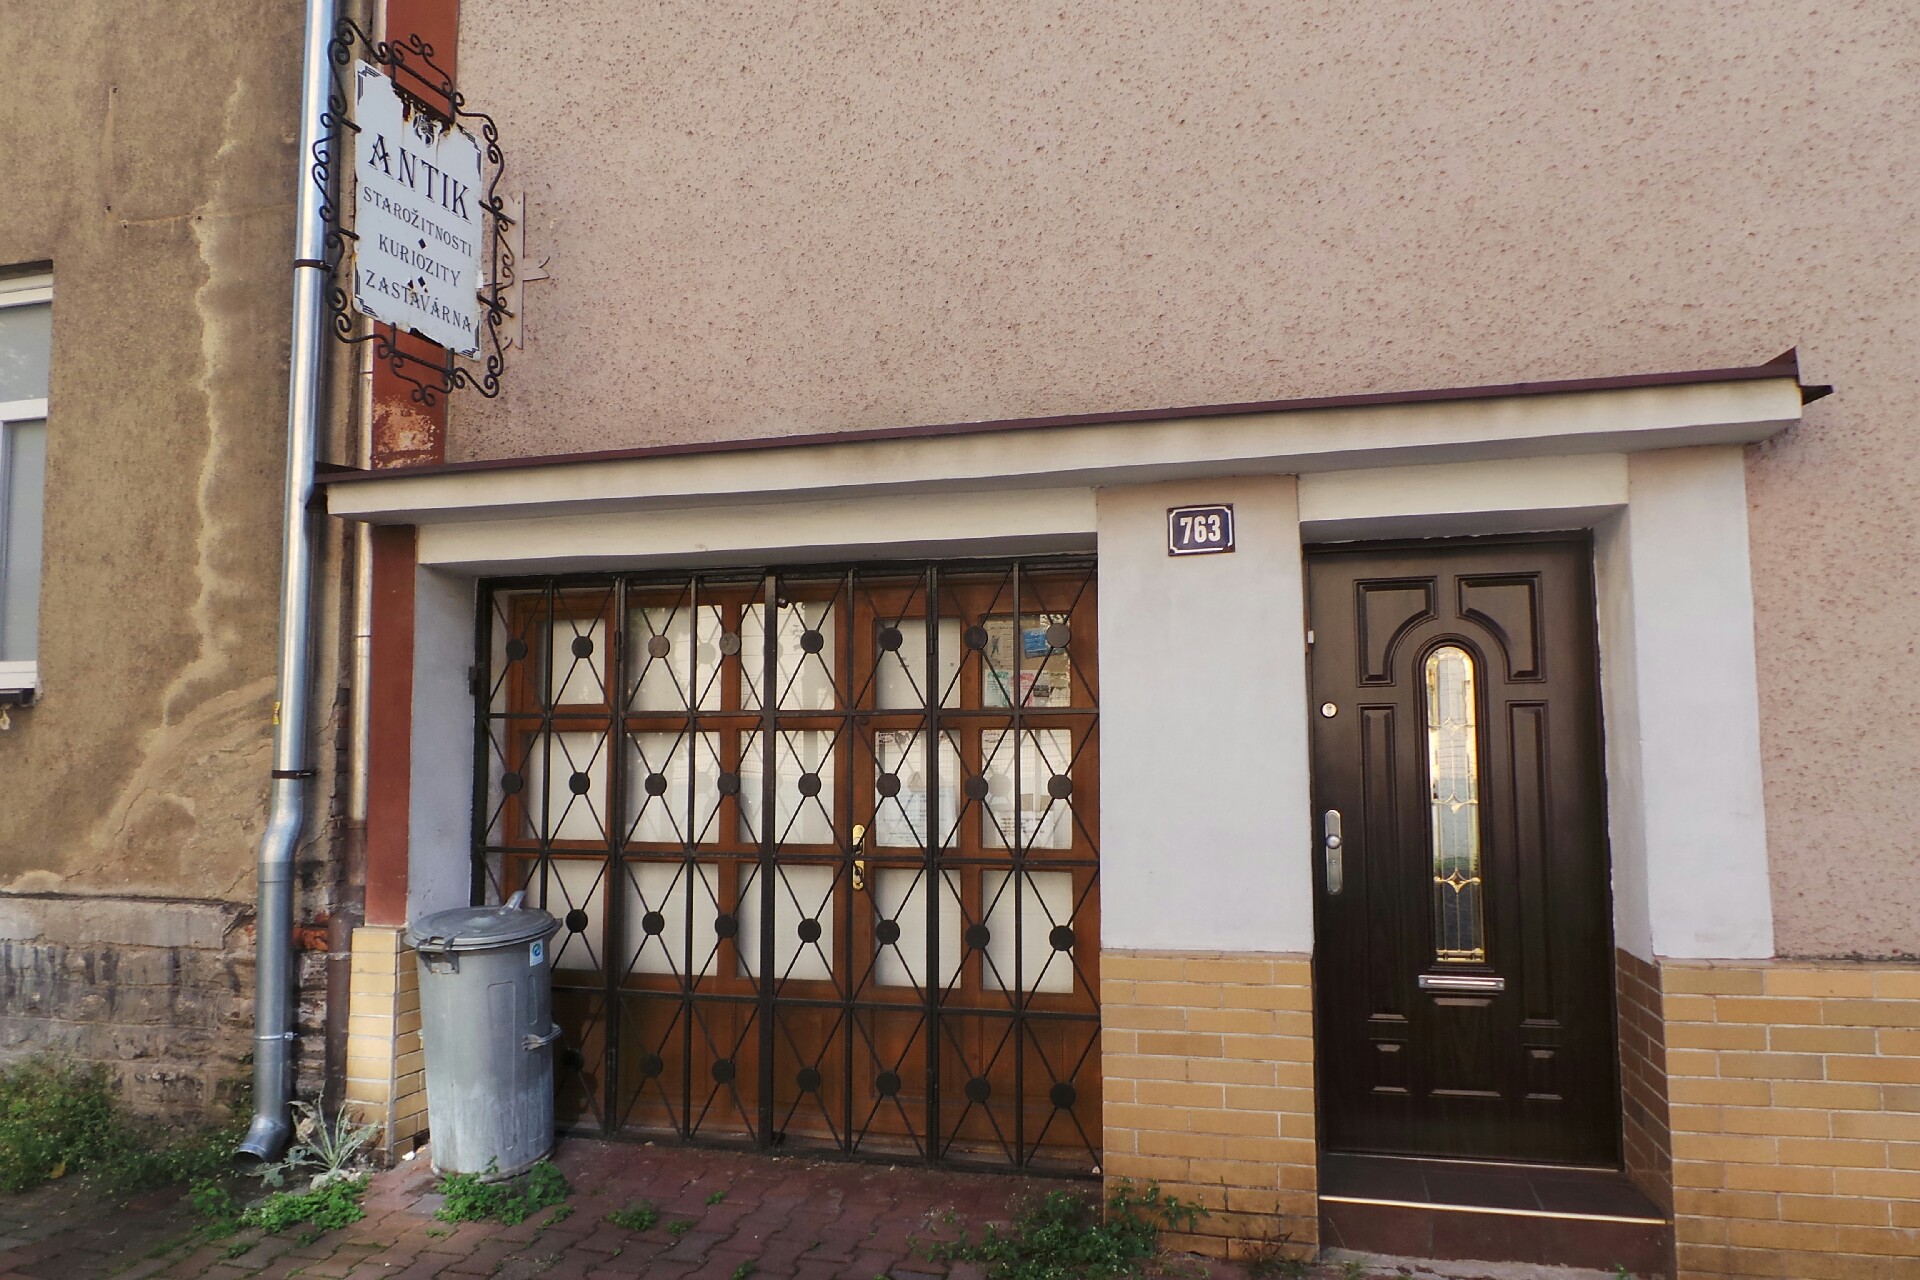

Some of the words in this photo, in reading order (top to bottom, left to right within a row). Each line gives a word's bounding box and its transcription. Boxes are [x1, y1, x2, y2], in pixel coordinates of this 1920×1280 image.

[367, 133, 470, 222] ANTIK
[363, 186, 472, 257] STAROŽITNOSTI
[379, 234, 461, 287] KURIOZITY
[365, 269, 472, 333] ZASTAVÁRNA
[1180, 514, 1221, 544] 763
